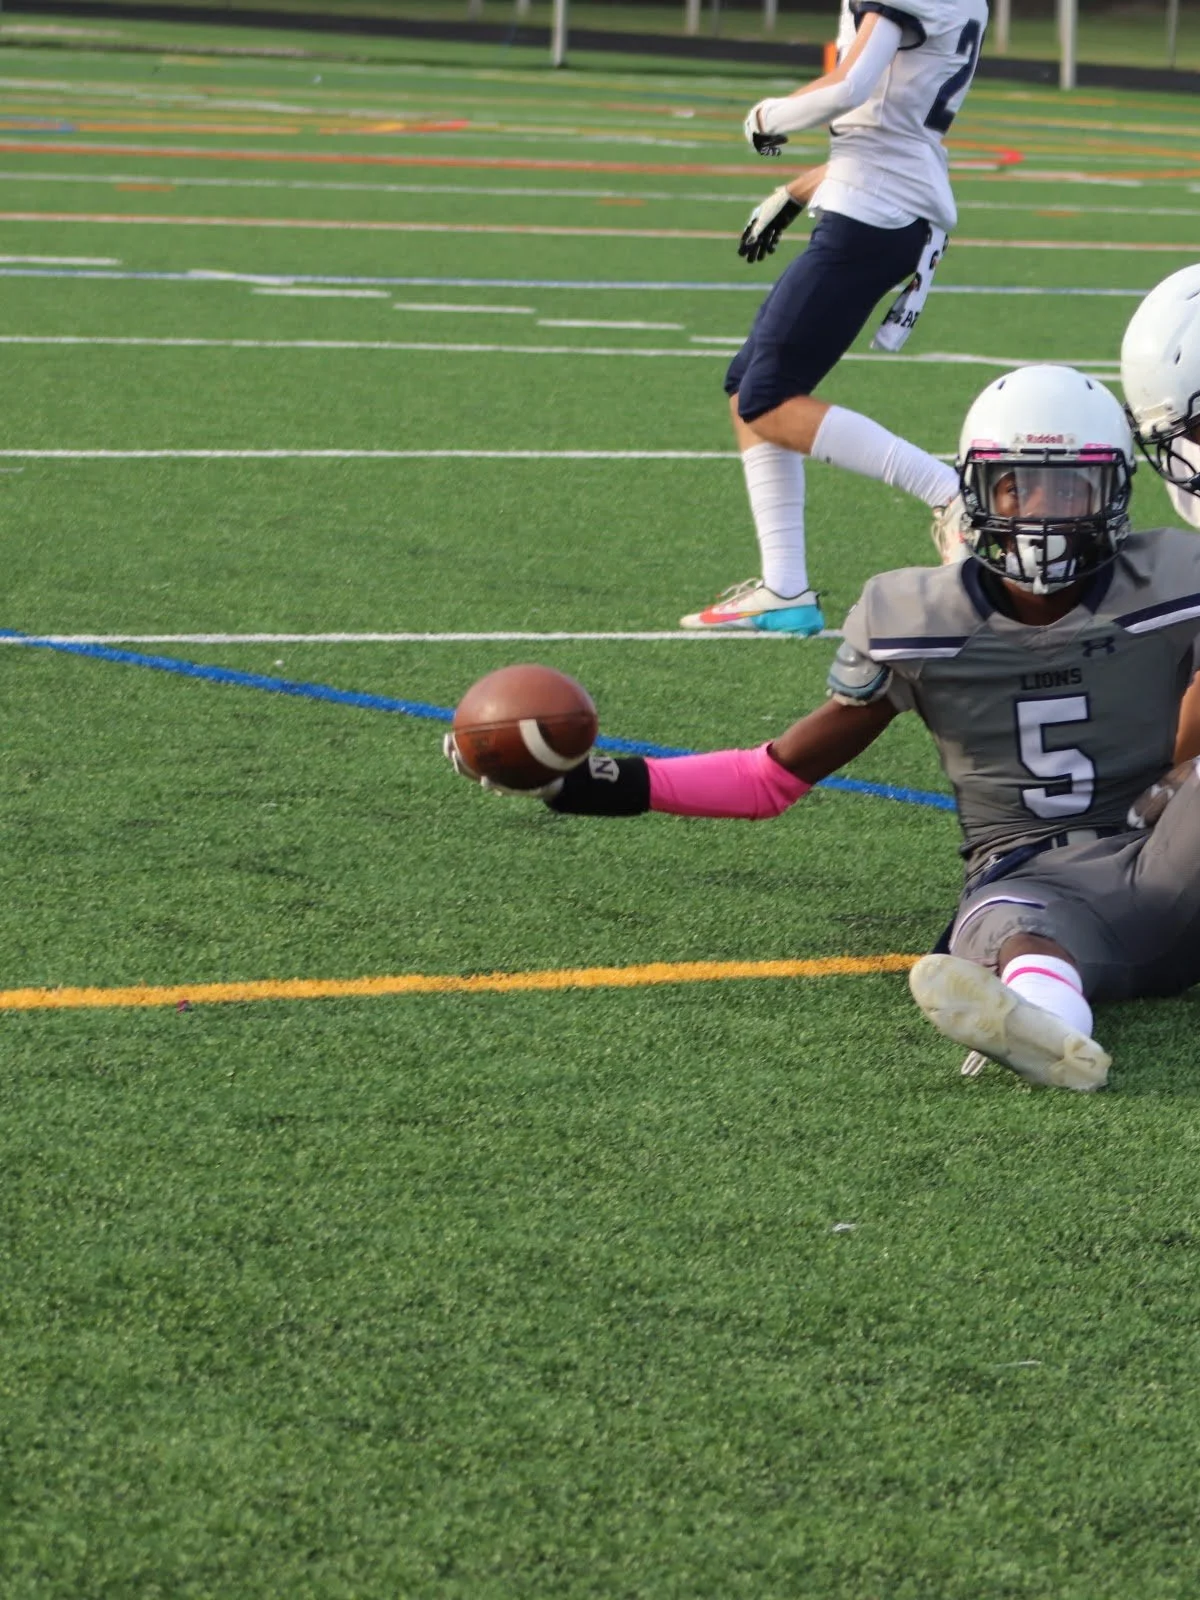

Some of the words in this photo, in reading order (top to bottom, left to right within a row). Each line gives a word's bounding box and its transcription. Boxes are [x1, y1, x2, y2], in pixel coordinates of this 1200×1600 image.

[924, 18, 980, 134] 2
[1026, 433, 1065, 444] Riddell
[1020, 667, 1082, 691] LIONS
[1015, 693, 1096, 820] 5
